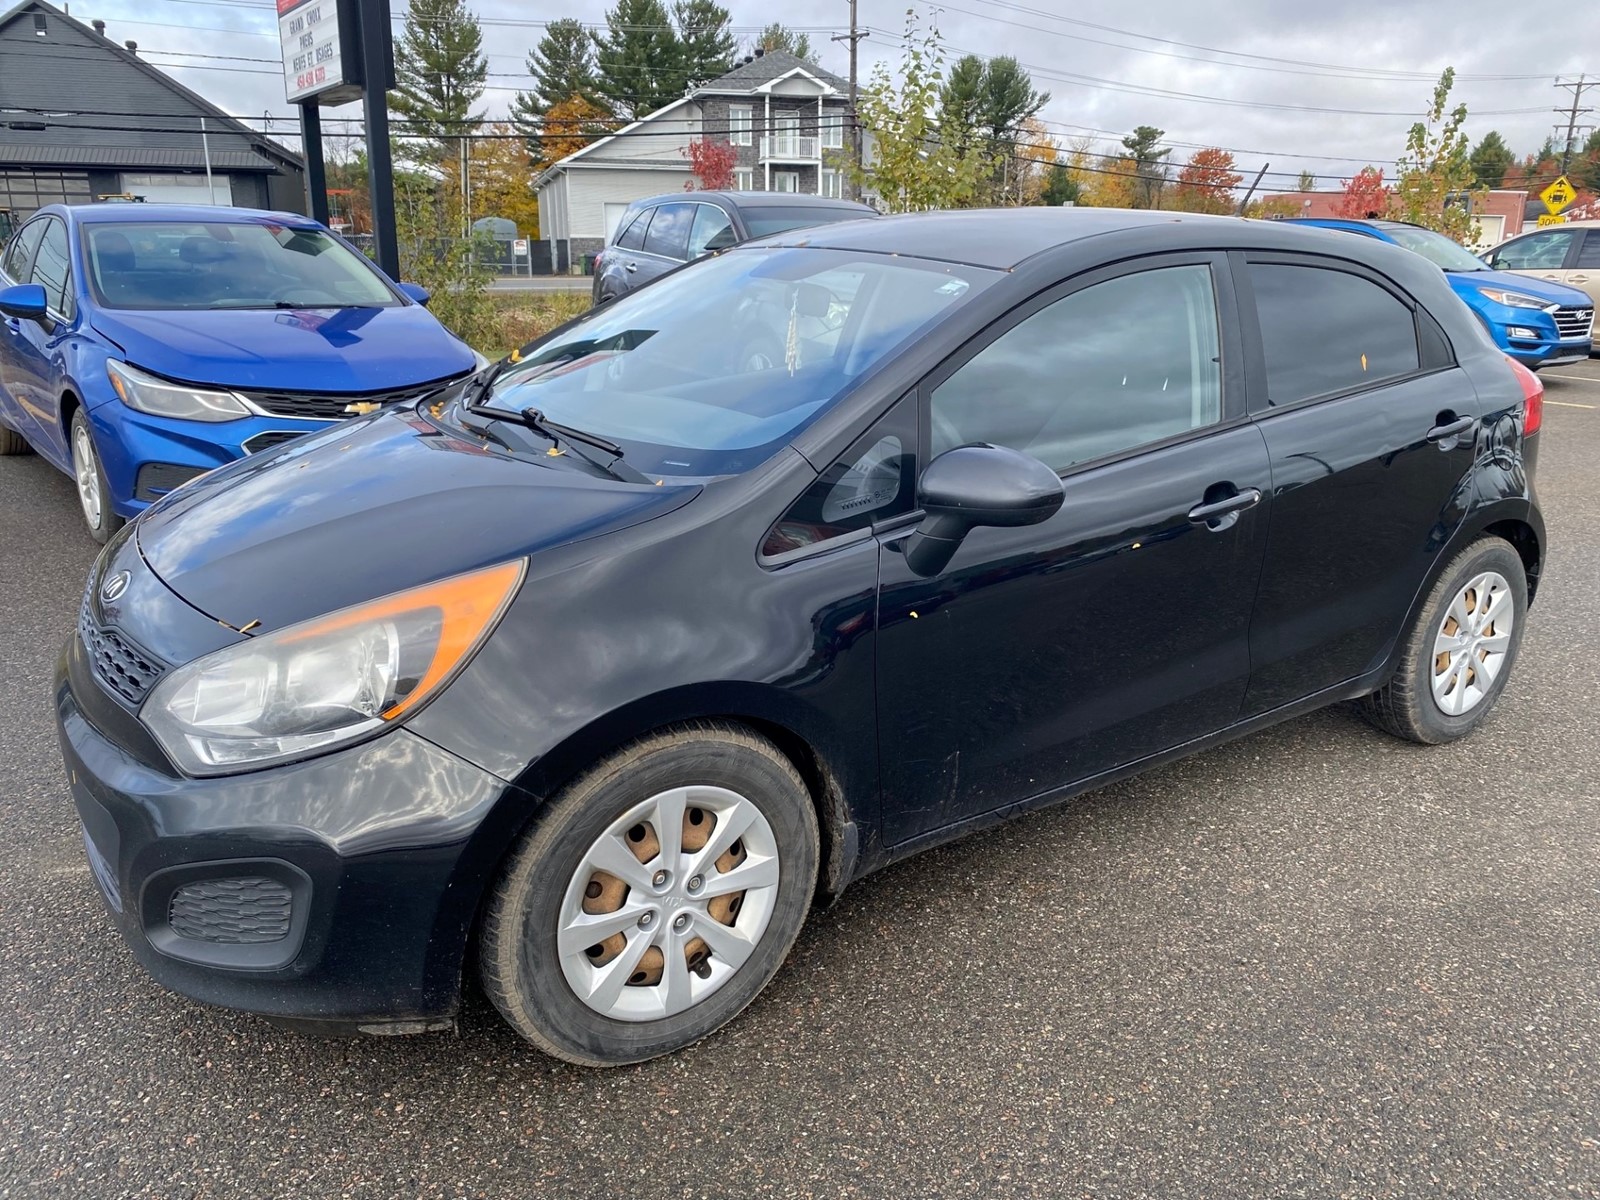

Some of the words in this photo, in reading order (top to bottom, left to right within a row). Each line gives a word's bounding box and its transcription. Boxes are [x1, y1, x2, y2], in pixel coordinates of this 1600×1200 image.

[289, 16, 304, 35] GRAND
[306, 6, 321, 26] CHOIX
[299, 32, 313, 49] PNEUS
[307, 51, 313, 66] ET
